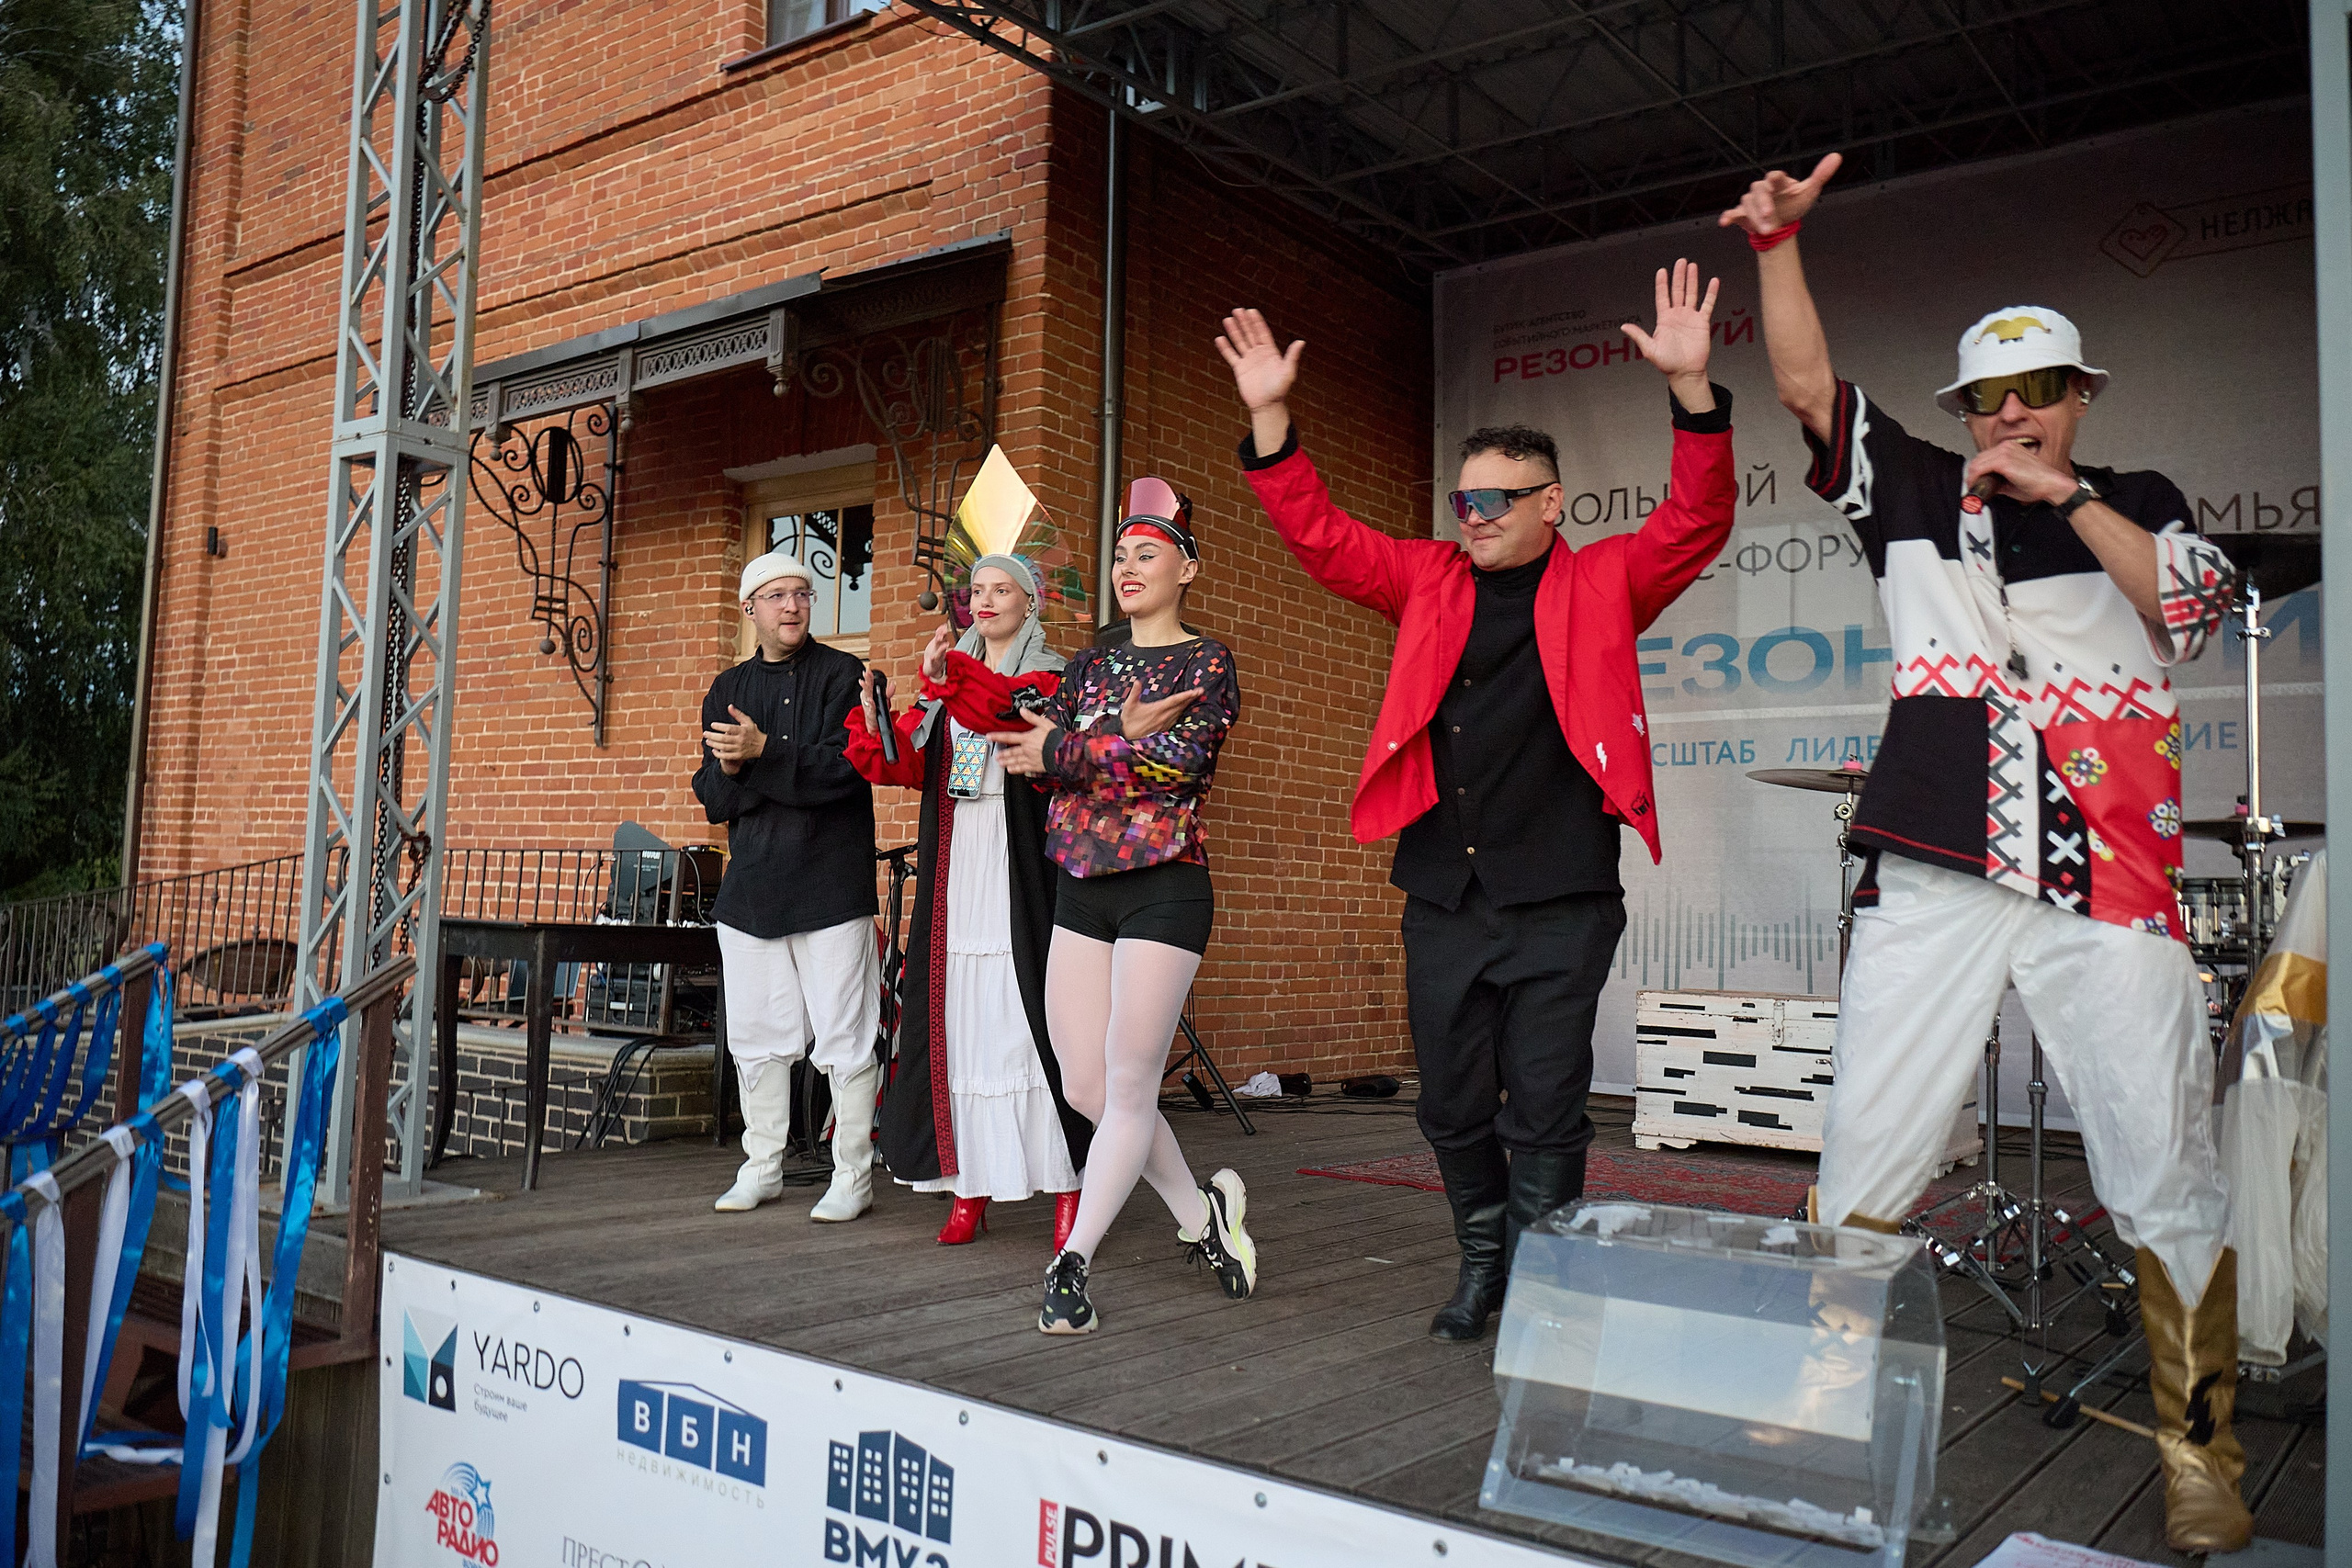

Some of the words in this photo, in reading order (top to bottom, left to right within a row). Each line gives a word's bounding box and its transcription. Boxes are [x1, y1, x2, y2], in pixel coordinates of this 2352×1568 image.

[1494, 309, 1755, 384] РЕЗОНЙ
[2198, 486, 2321, 533] МЬЯ
[1652, 739, 1756, 767] СШТАБ
[473, 1330, 584, 1399] YARDO
[425, 1489, 473, 1528] АВТО
[437, 1518, 499, 1567] РАДИО
[1044, 1505, 1058, 1564] PULSE
